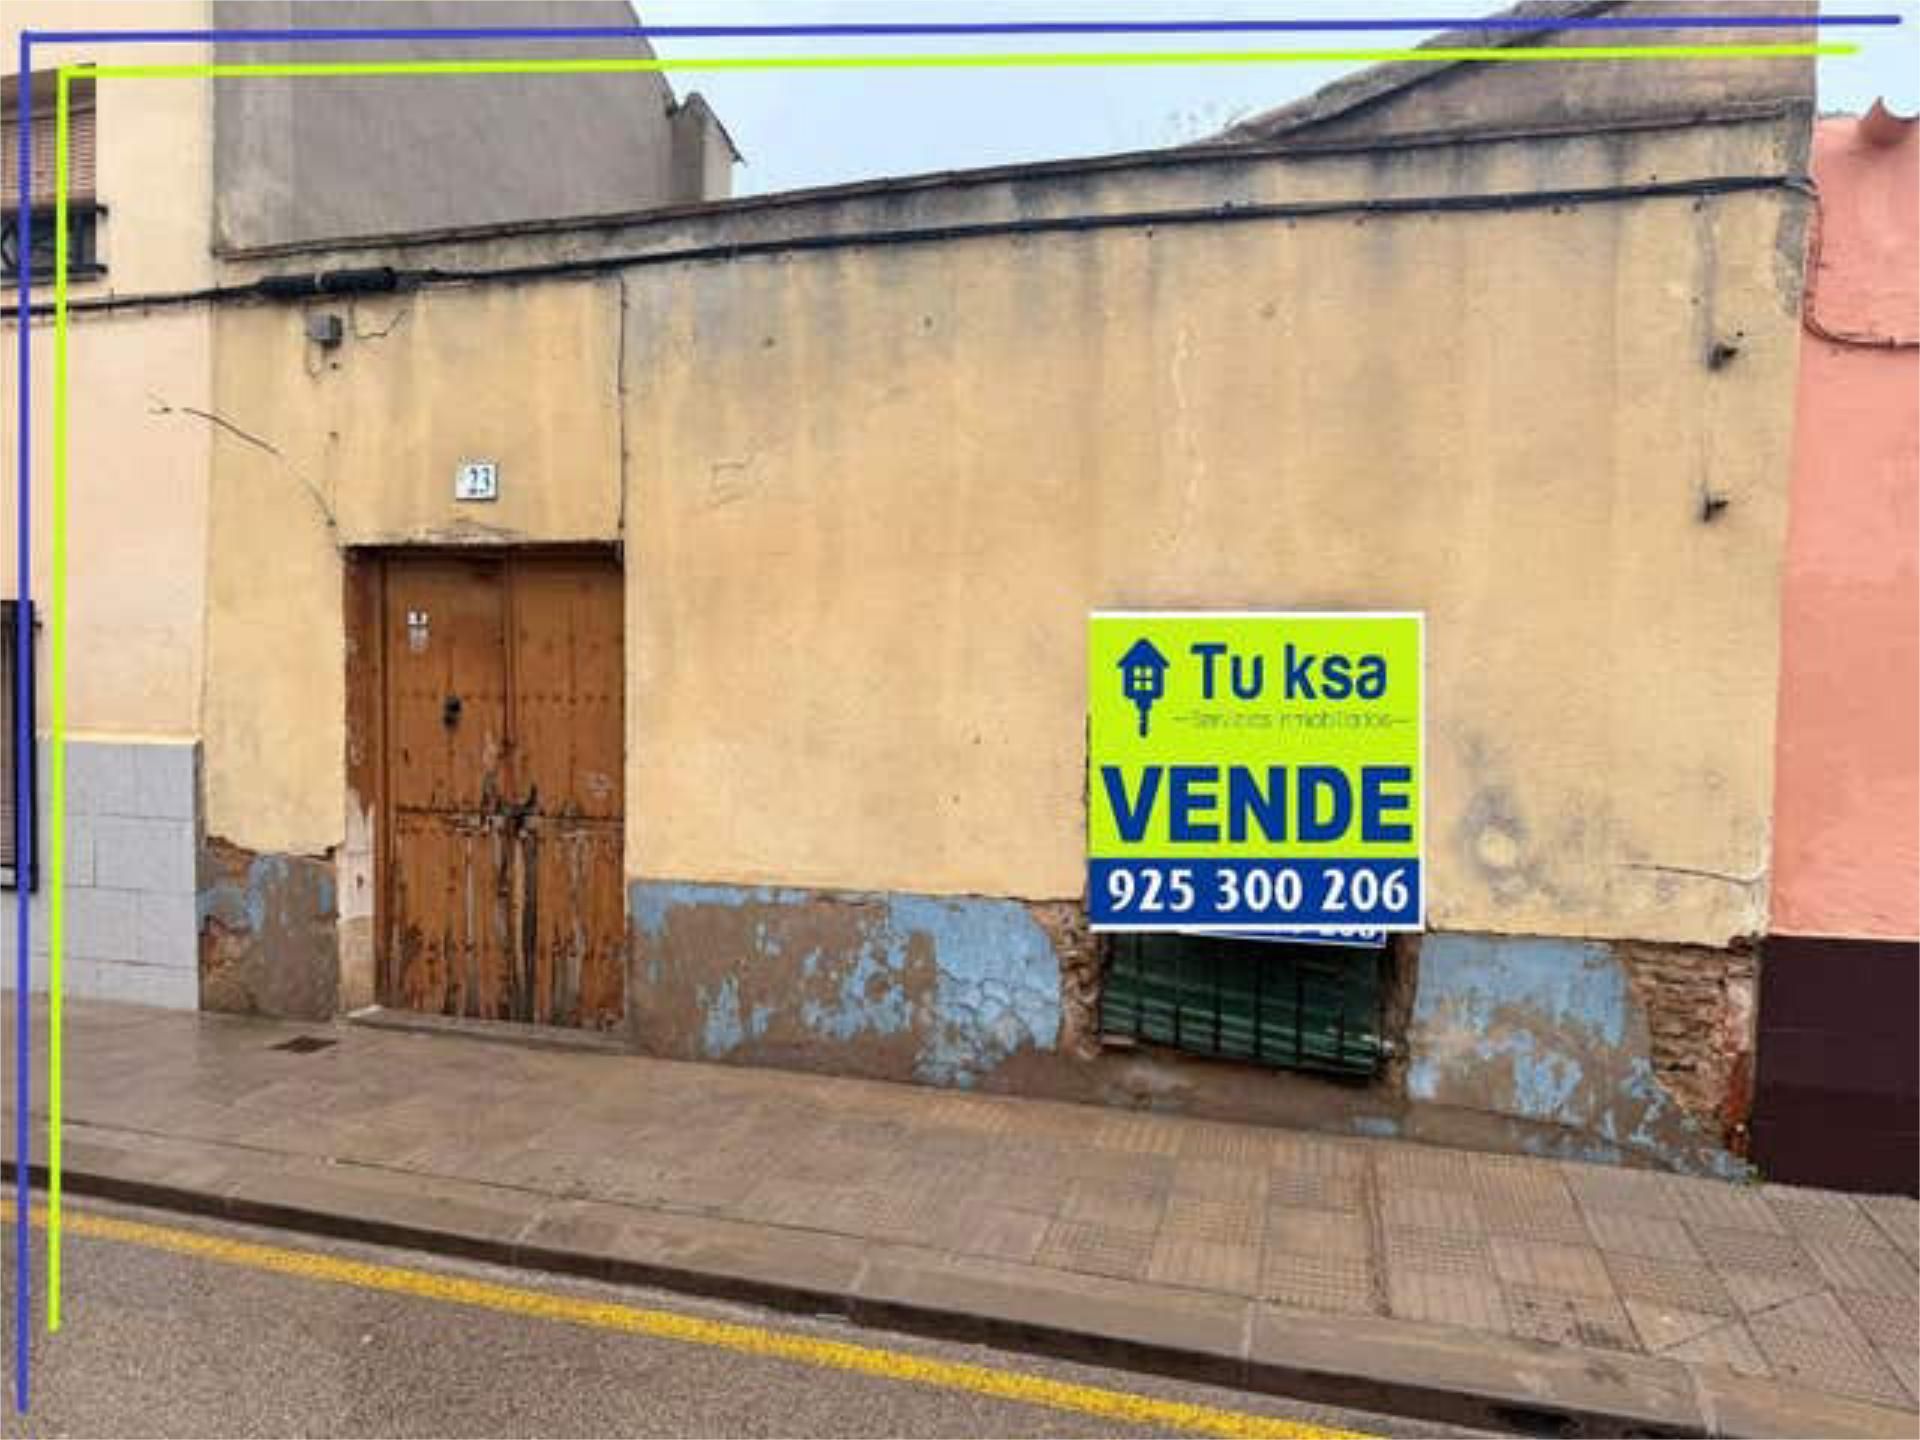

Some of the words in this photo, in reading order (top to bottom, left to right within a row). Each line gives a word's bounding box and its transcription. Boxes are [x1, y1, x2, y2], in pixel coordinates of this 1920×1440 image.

[468, 466, 490, 496] 23
[1190, 643, 1263, 700] Tu
[1284, 643, 1387, 700] ksa
[1100, 765, 1413, 843] VENDE
[1108, 869, 1195, 912] 925
[1215, 869, 1303, 912] 300
[1321, 869, 1409, 912] 206
